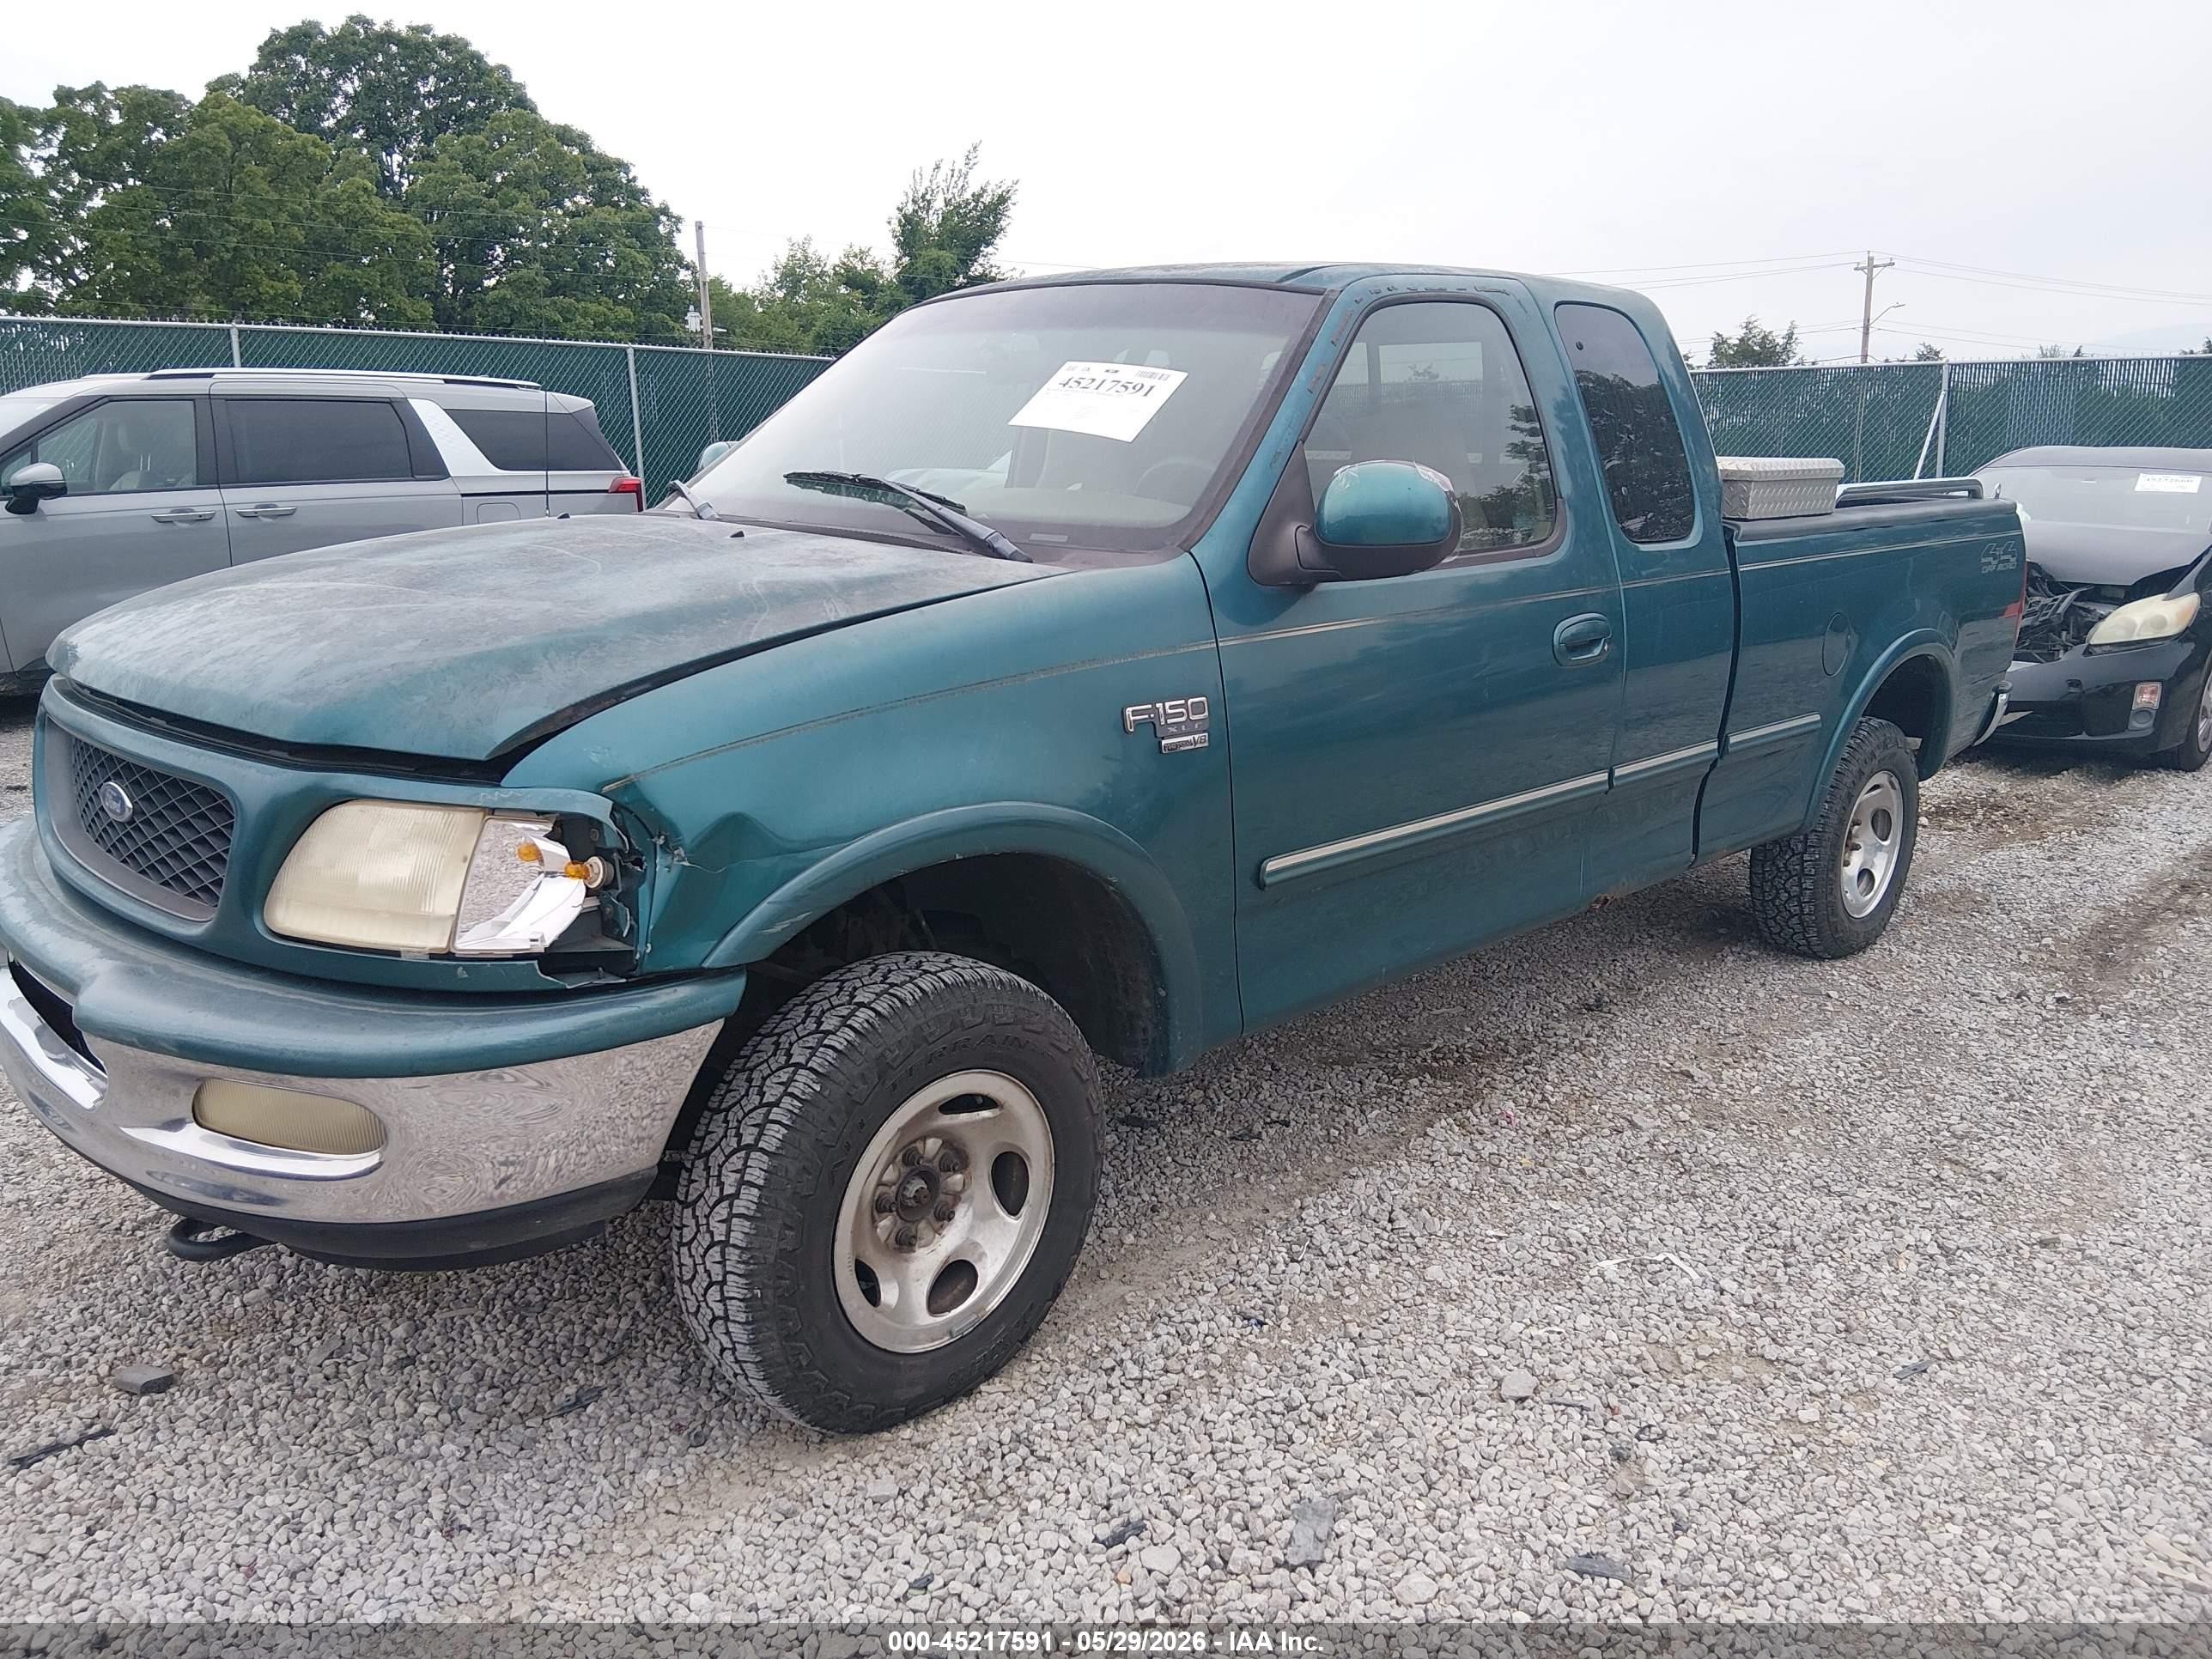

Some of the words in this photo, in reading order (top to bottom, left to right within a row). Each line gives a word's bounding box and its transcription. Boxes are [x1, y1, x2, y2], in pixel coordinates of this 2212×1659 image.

[1059, 376, 1156, 397] 45217591
[1125, 696, 1209, 732] F-150
[1193, 734, 1206, 747] V8
